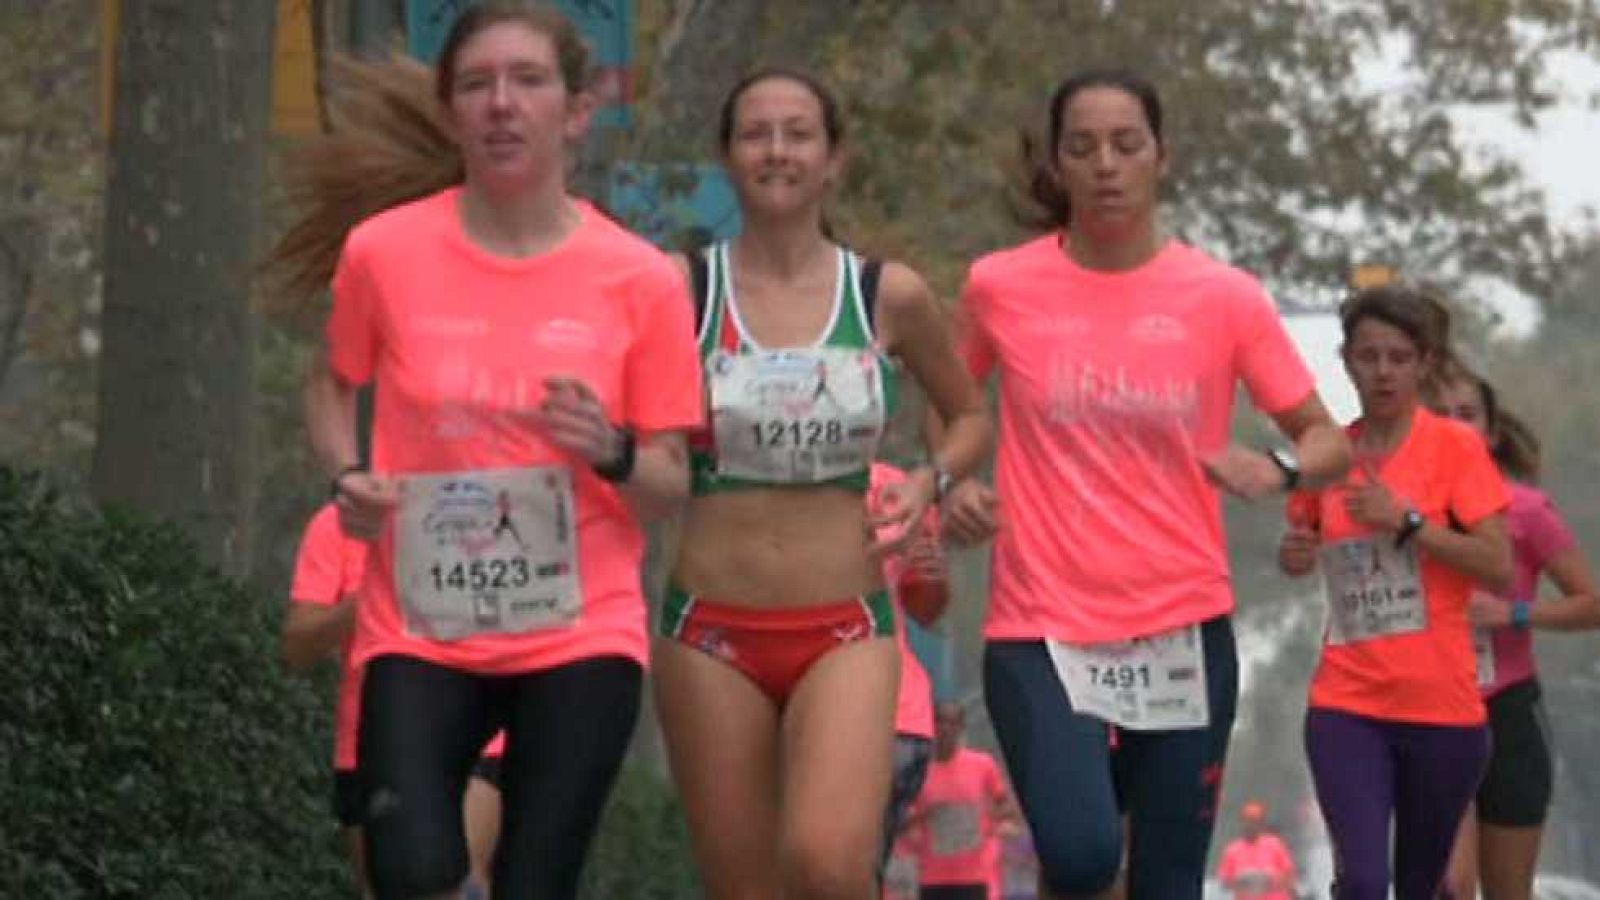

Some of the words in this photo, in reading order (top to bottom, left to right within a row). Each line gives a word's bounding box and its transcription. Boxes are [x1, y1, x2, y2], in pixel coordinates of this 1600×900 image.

[751, 418, 842, 446] 12128
[430, 558, 530, 591] 14523
[1088, 664, 1150, 689] 7491
